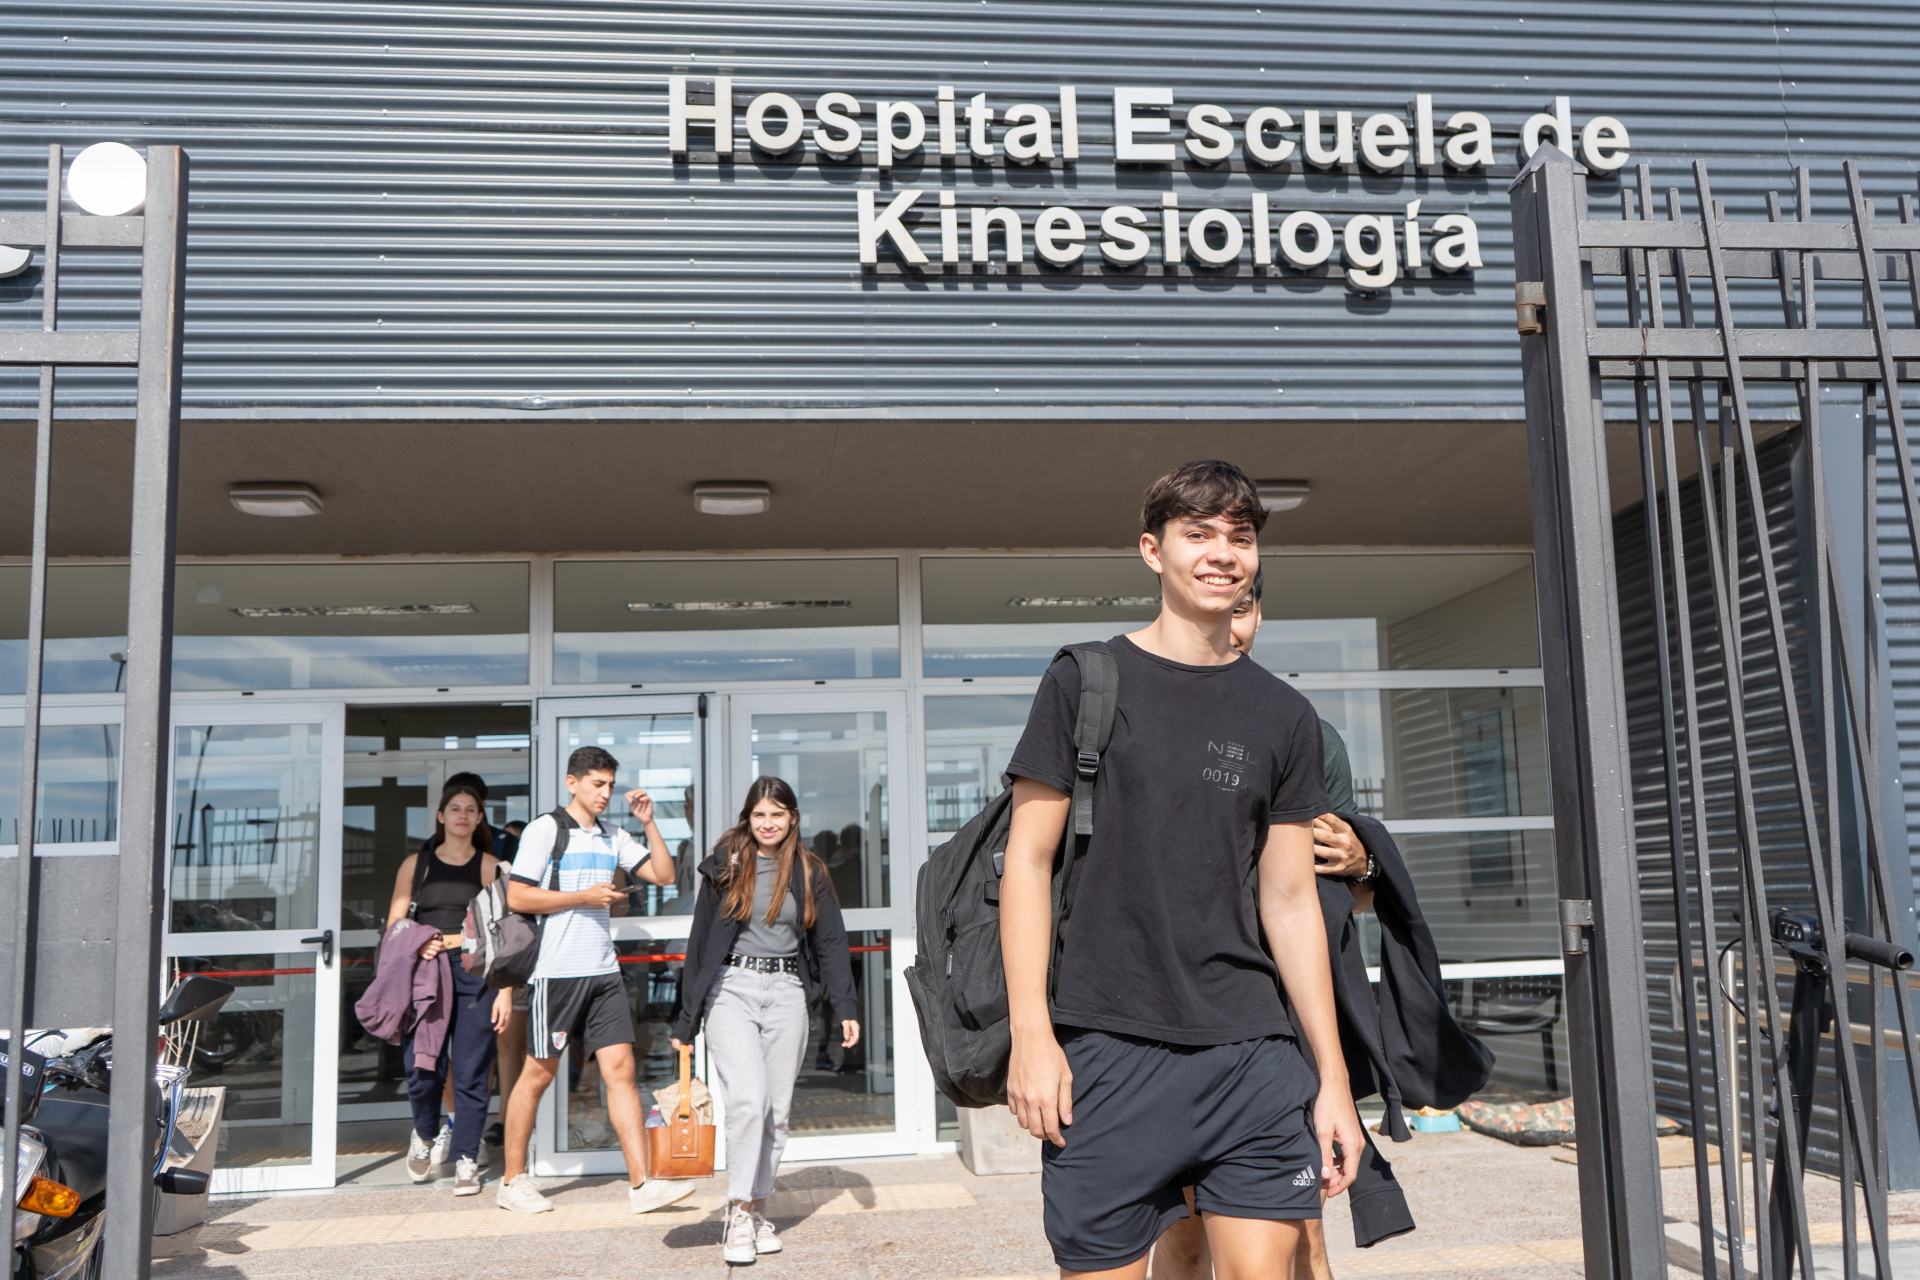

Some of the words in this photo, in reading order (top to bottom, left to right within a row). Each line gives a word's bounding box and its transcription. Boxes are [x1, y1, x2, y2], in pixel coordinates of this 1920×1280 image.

[669, 76, 1080, 170] Hospital
[1113, 87, 1496, 172] Escuela
[1519, 96, 1631, 172] de
[857, 190, 1484, 291] Kinesiología
